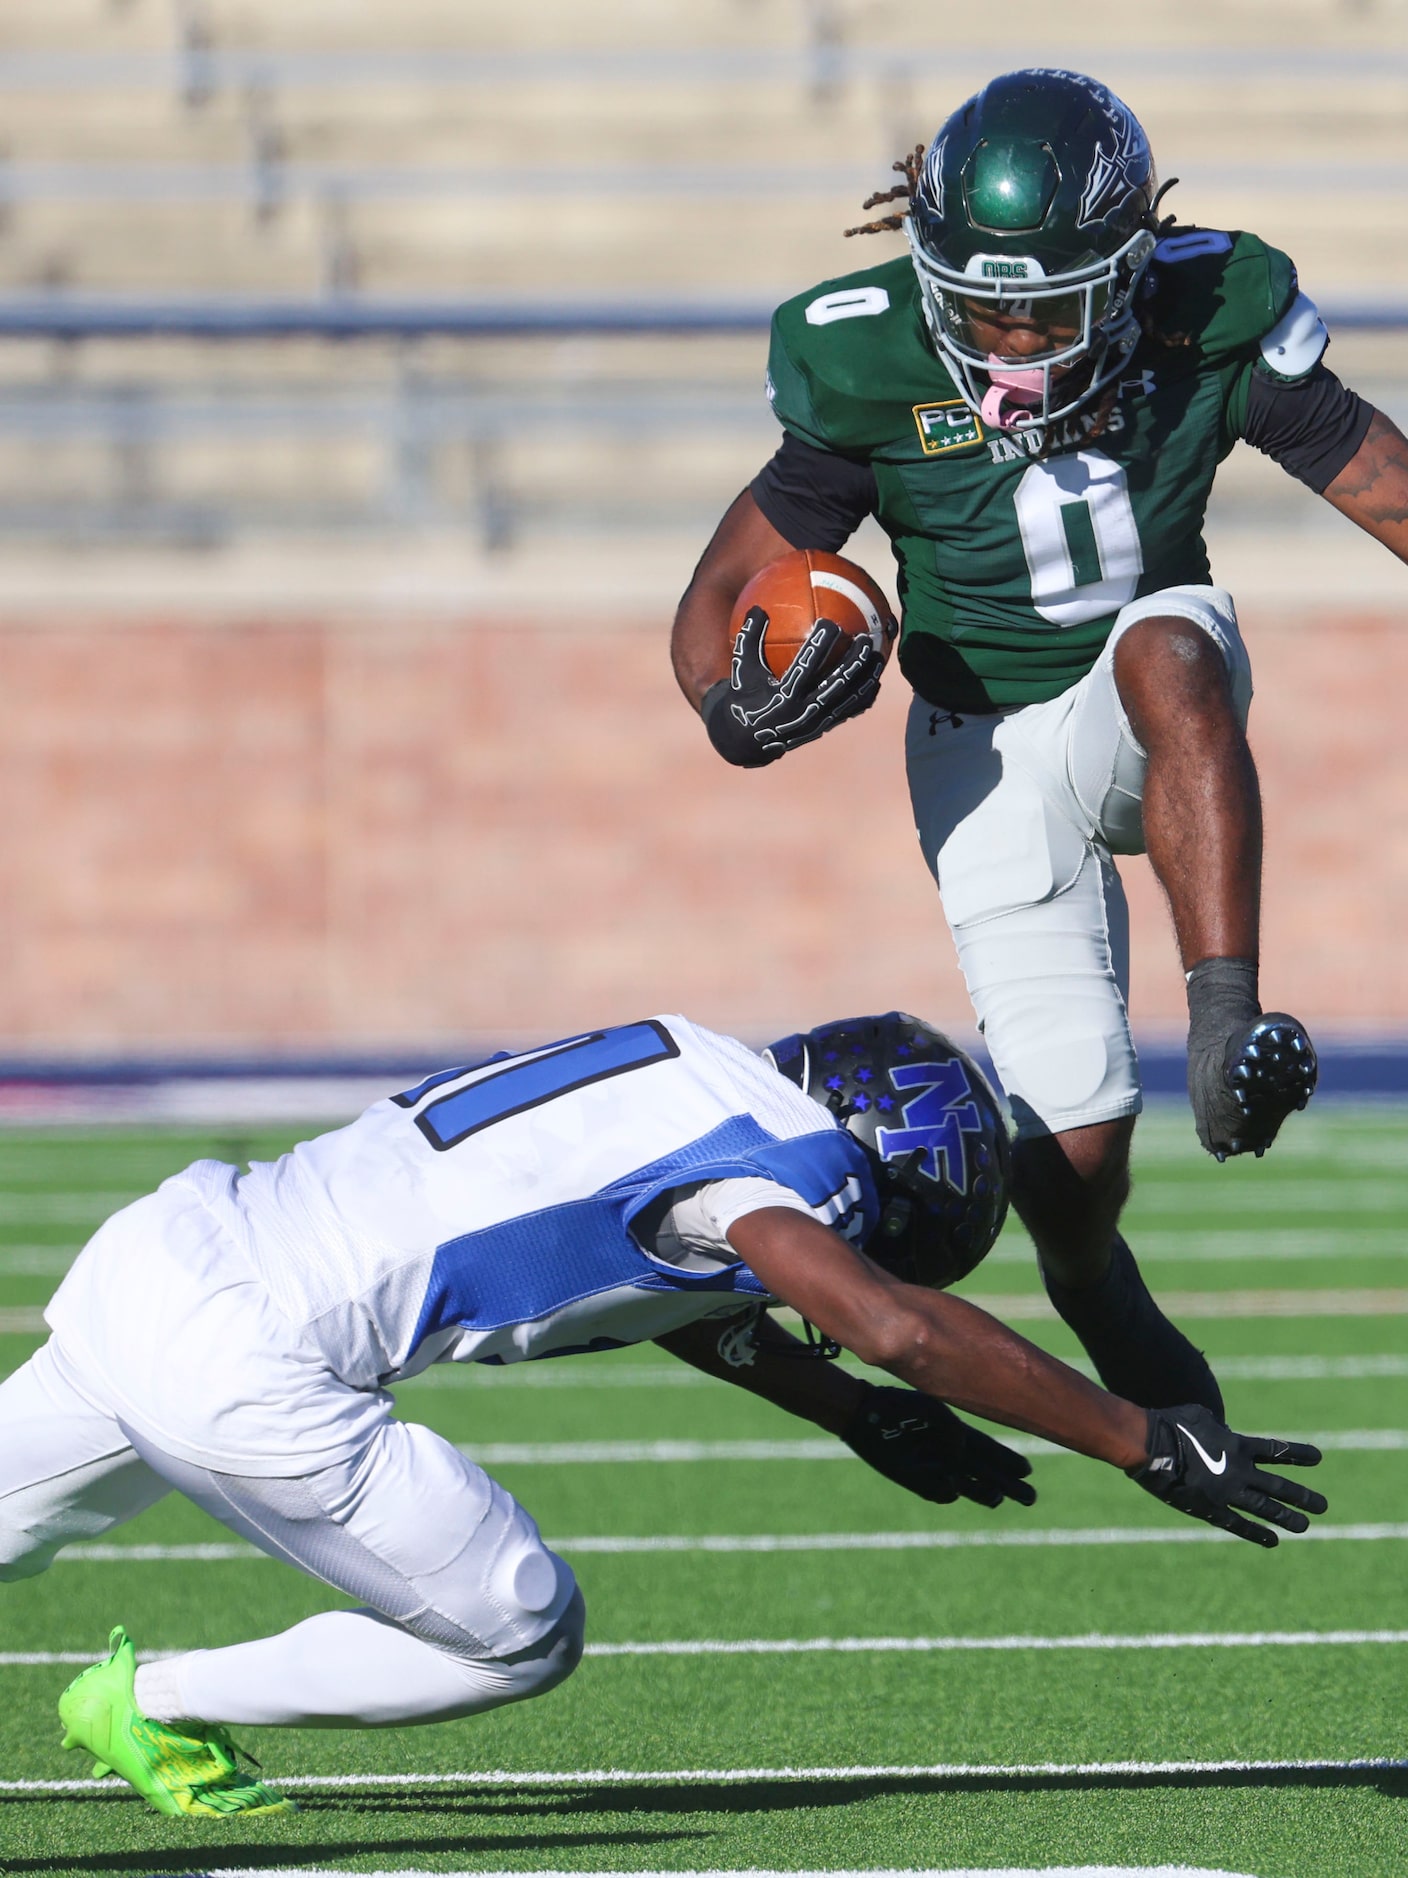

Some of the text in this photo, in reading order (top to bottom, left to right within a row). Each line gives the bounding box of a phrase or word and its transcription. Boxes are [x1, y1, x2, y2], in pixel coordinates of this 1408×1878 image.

[1153, 231, 1233, 263] 0
[805, 286, 890, 326] 0
[920, 406, 973, 434] PC
[1013, 448, 1144, 627] 0
[875, 1057, 982, 1196] NF
